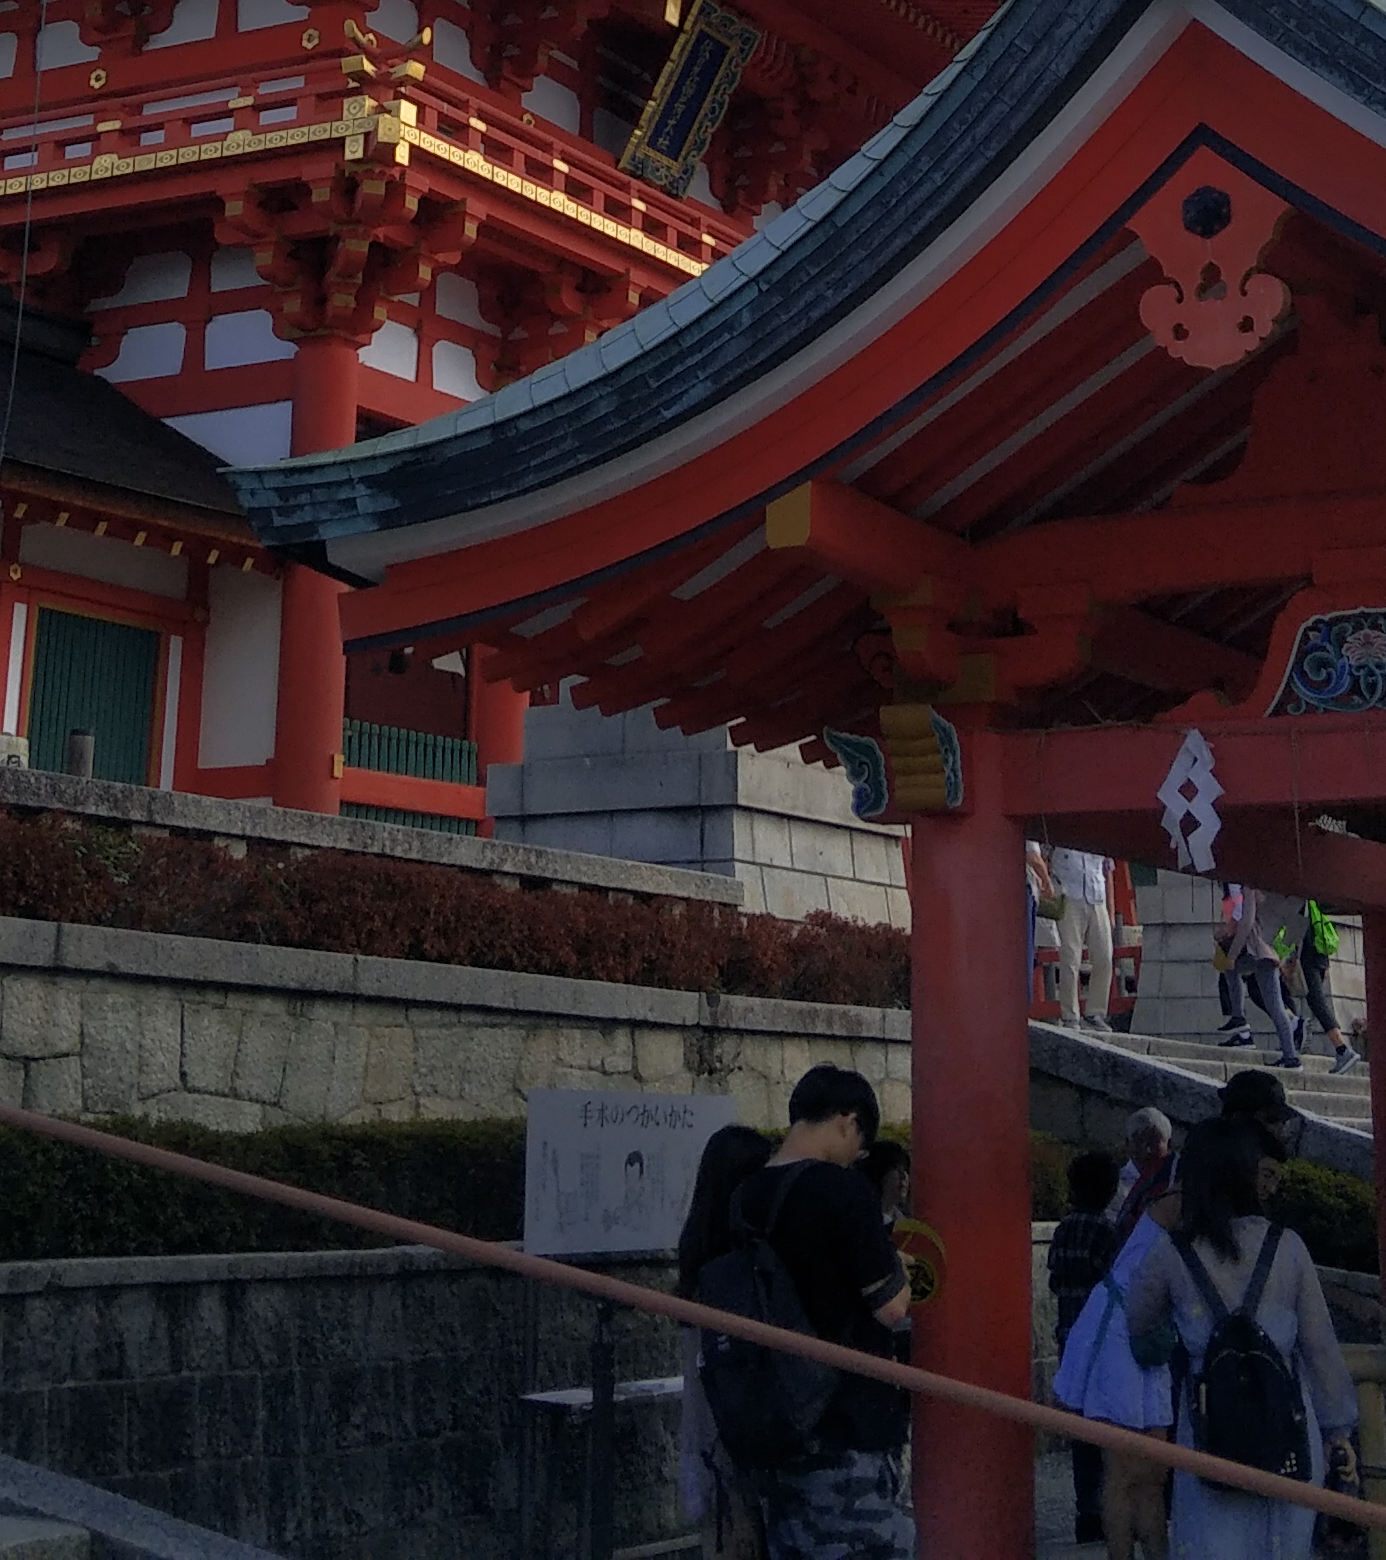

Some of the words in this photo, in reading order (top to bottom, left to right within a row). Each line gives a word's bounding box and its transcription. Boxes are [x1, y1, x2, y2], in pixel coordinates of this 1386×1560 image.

[578, 1100, 695, 1129] 手水のつかいかた
